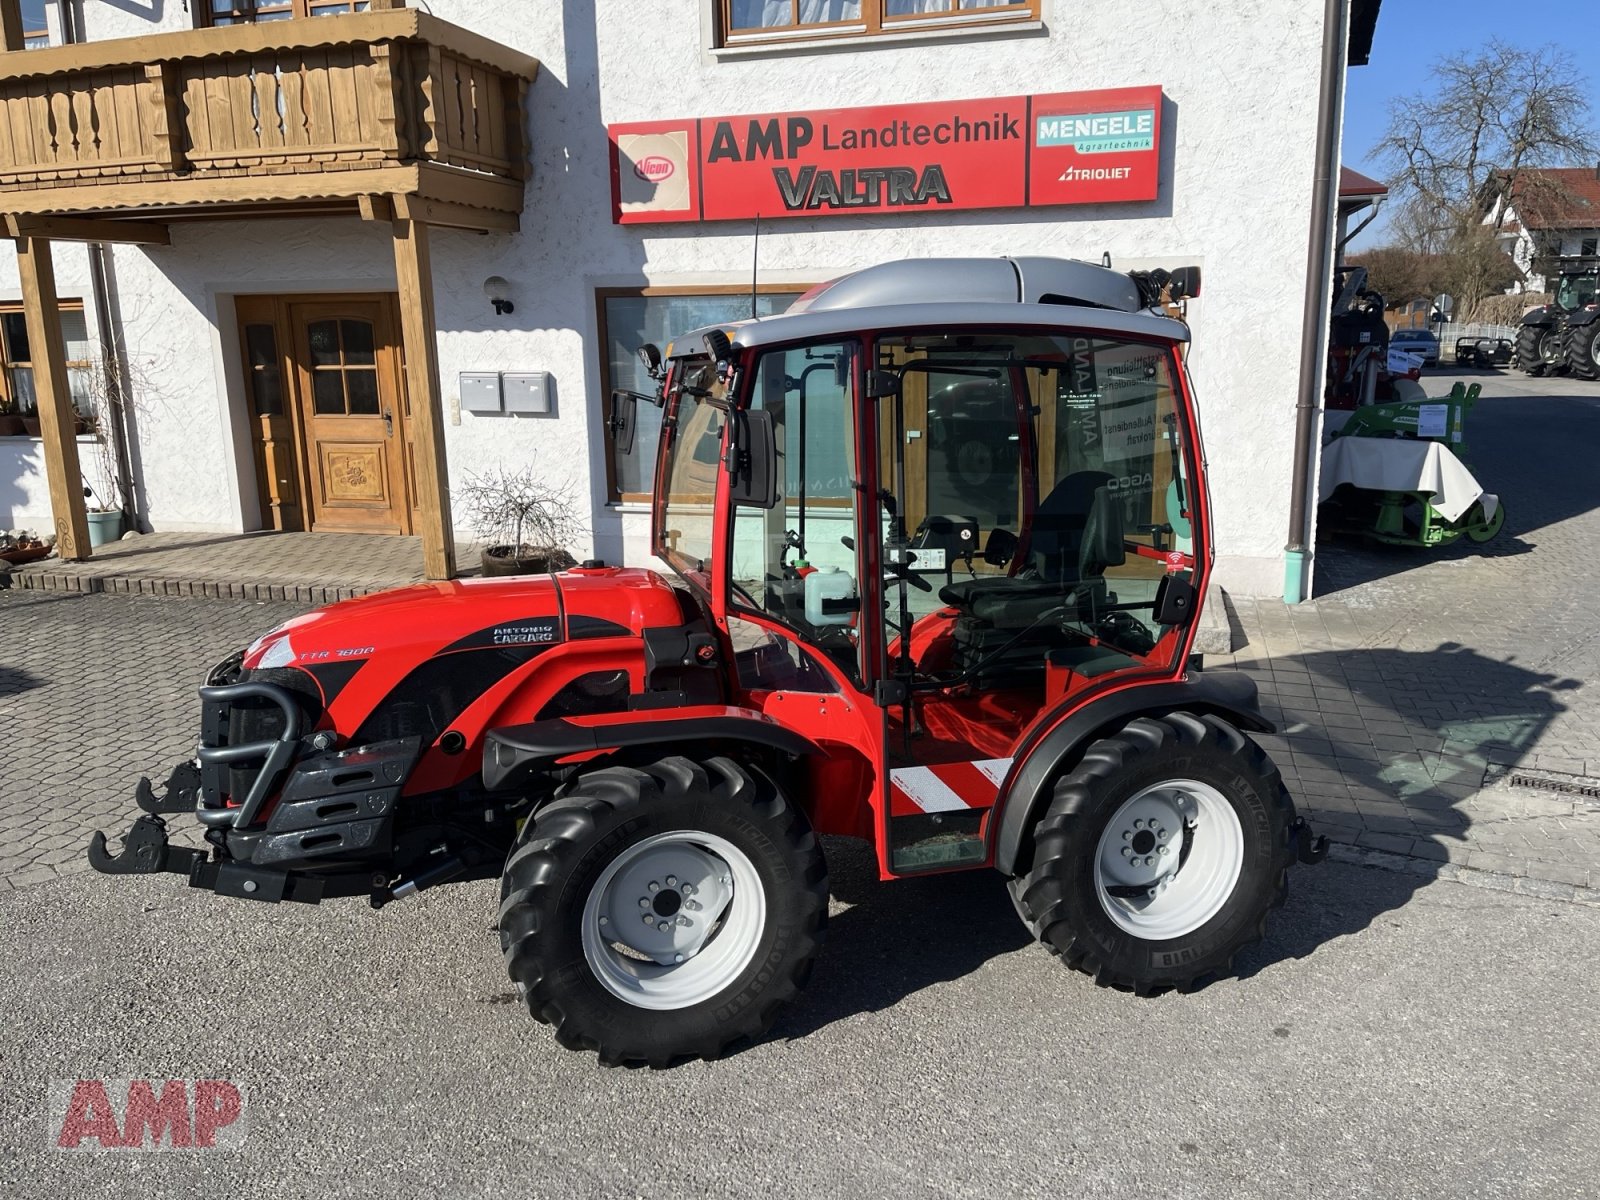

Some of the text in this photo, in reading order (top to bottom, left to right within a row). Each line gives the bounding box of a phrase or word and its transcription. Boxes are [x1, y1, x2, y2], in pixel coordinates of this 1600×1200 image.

[1040, 115, 1151, 139] MENGELE
[708, 113, 1020, 163] AMP Landtechnik
[1078, 140, 1151, 152] Agrartechnik
[1073, 167, 1132, 181] TRIOLIET
[771, 164, 954, 211] VALTRA
[493, 625, 553, 636] ANTONIO
[493, 632, 553, 645] CARRARO
[300, 651, 329, 661] TTR
